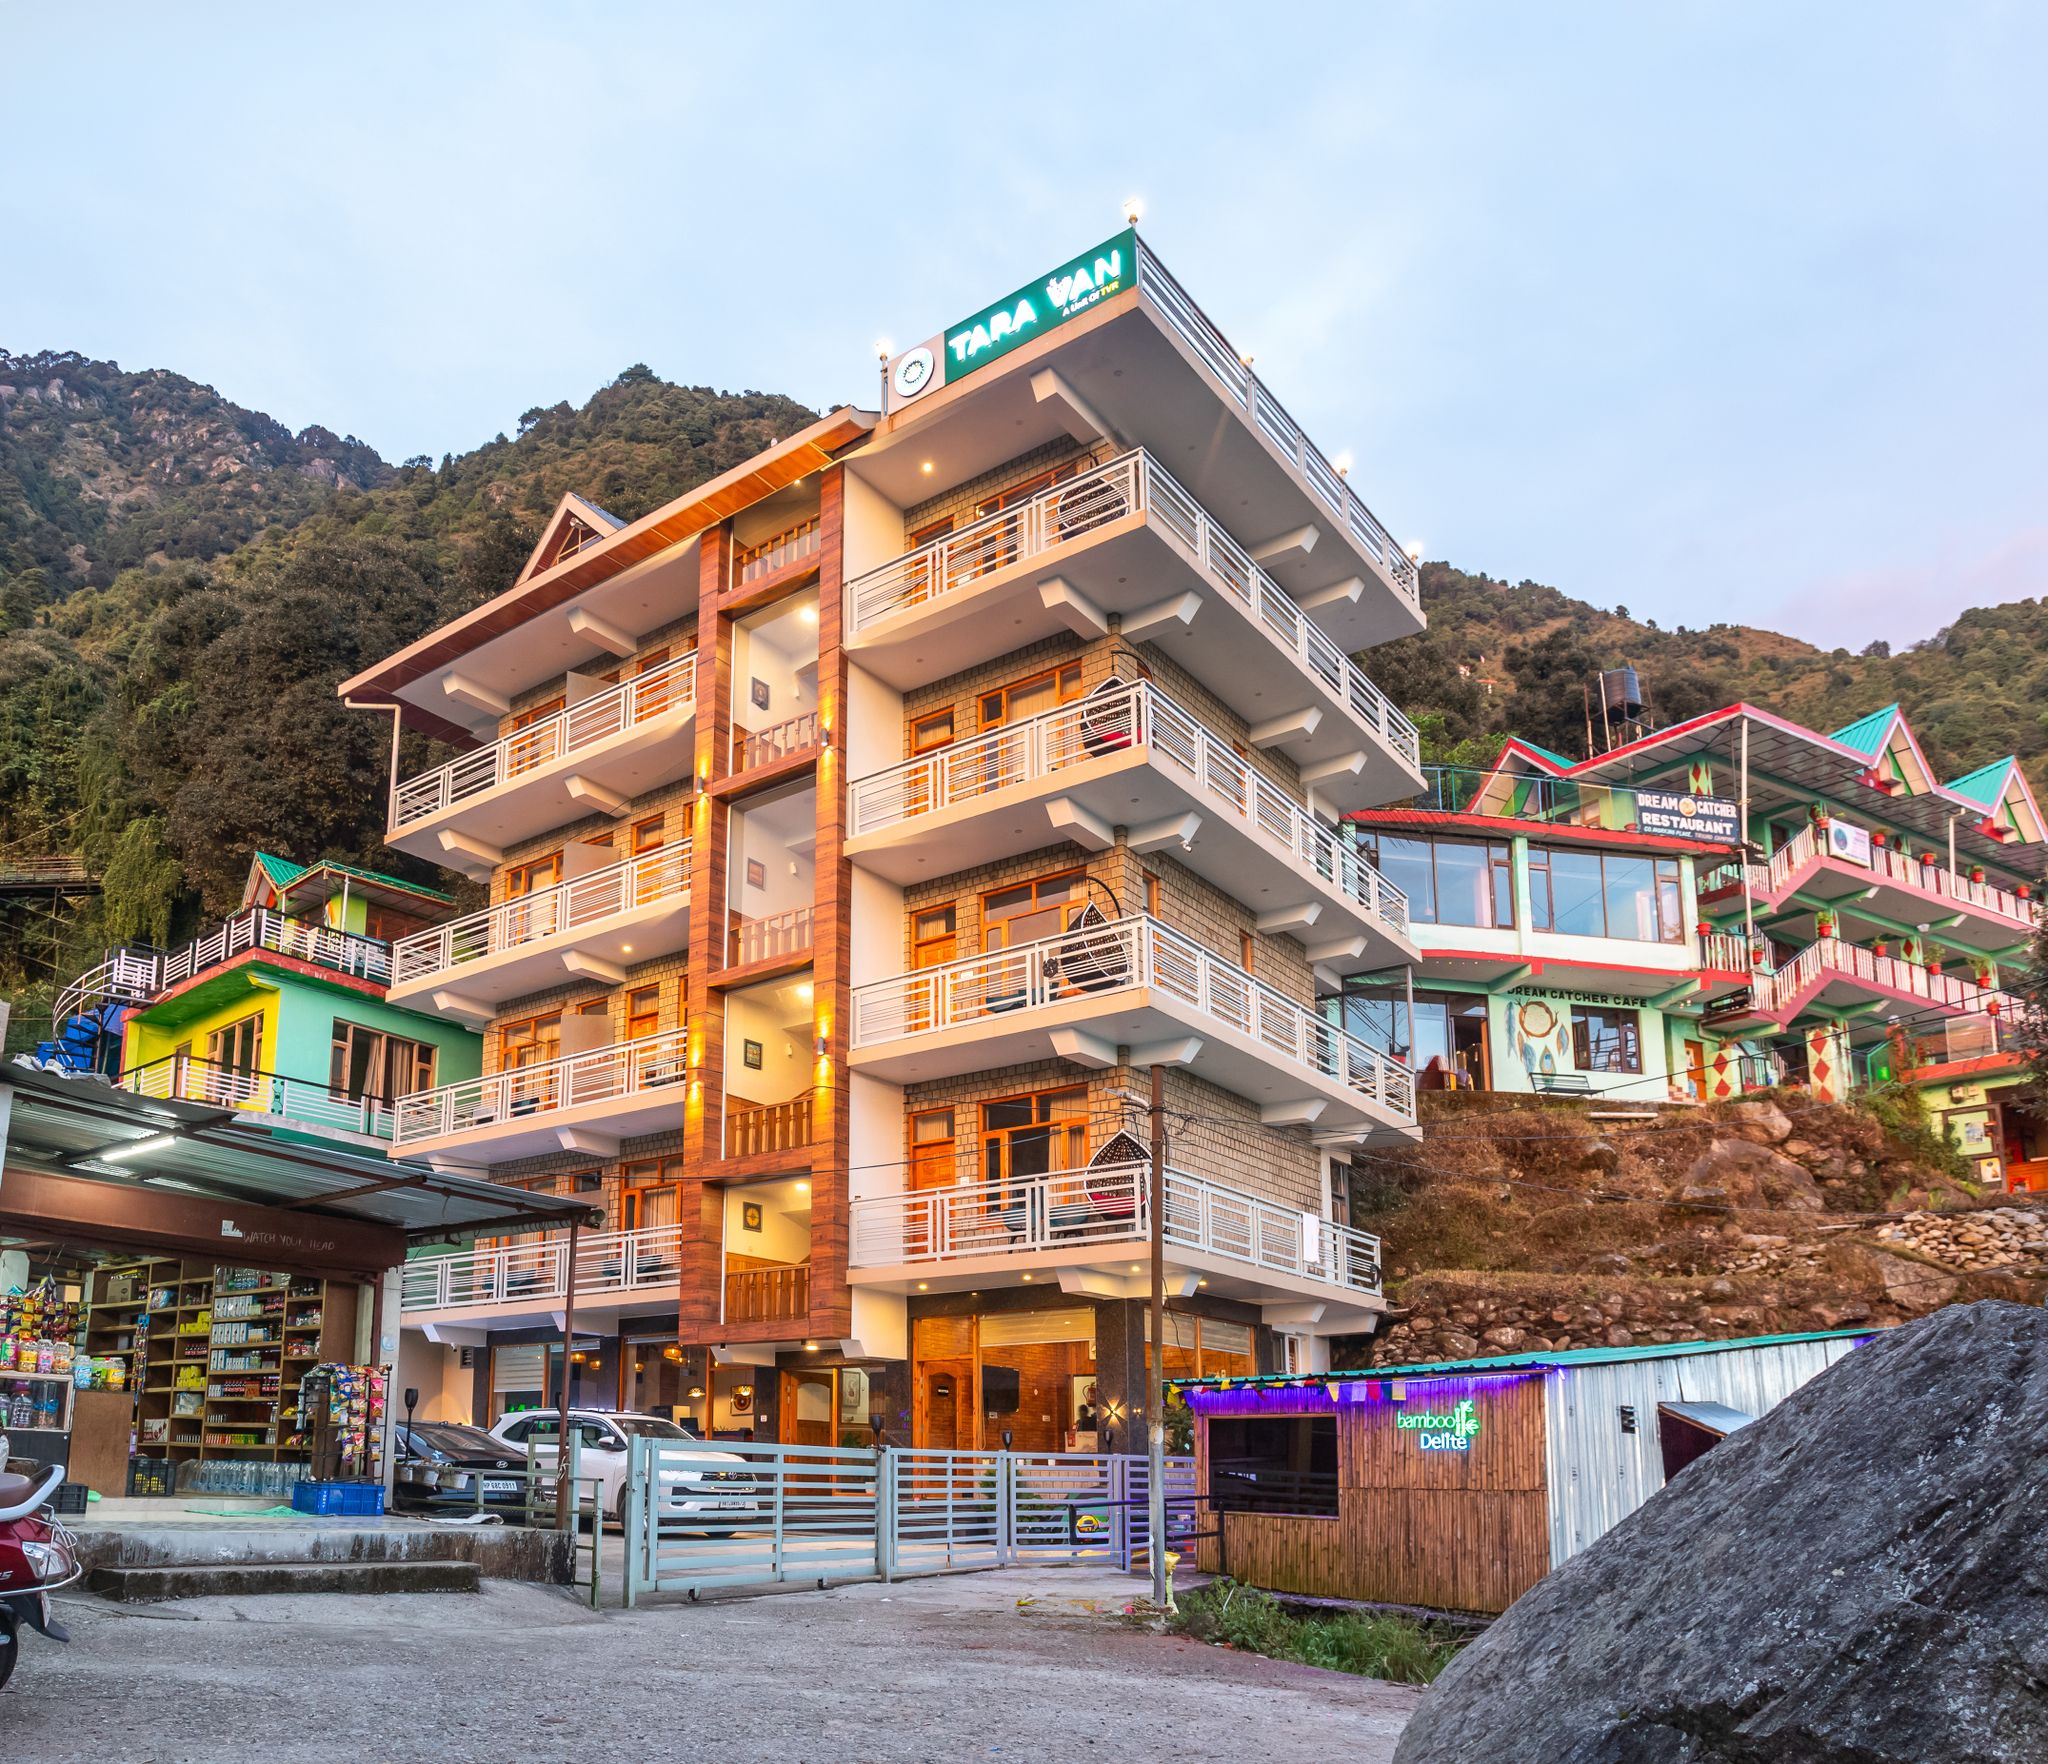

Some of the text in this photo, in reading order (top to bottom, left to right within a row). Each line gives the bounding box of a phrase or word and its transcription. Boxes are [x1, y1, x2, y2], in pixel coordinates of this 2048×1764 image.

[948, 249, 1121, 362] TARA VAN
[1062, 306, 1070, 317] A
[1100, 280, 1119, 296] TVR
[1638, 793, 1737, 818] DREAM CATCHER
[1642, 812, 1733, 835] RESTAURANT
[1507, 987, 1648, 1008] DREAM CATCHER CAFE
[1397, 1410, 1456, 1429] bamboo
[1420, 1432, 1468, 1450] Delite
